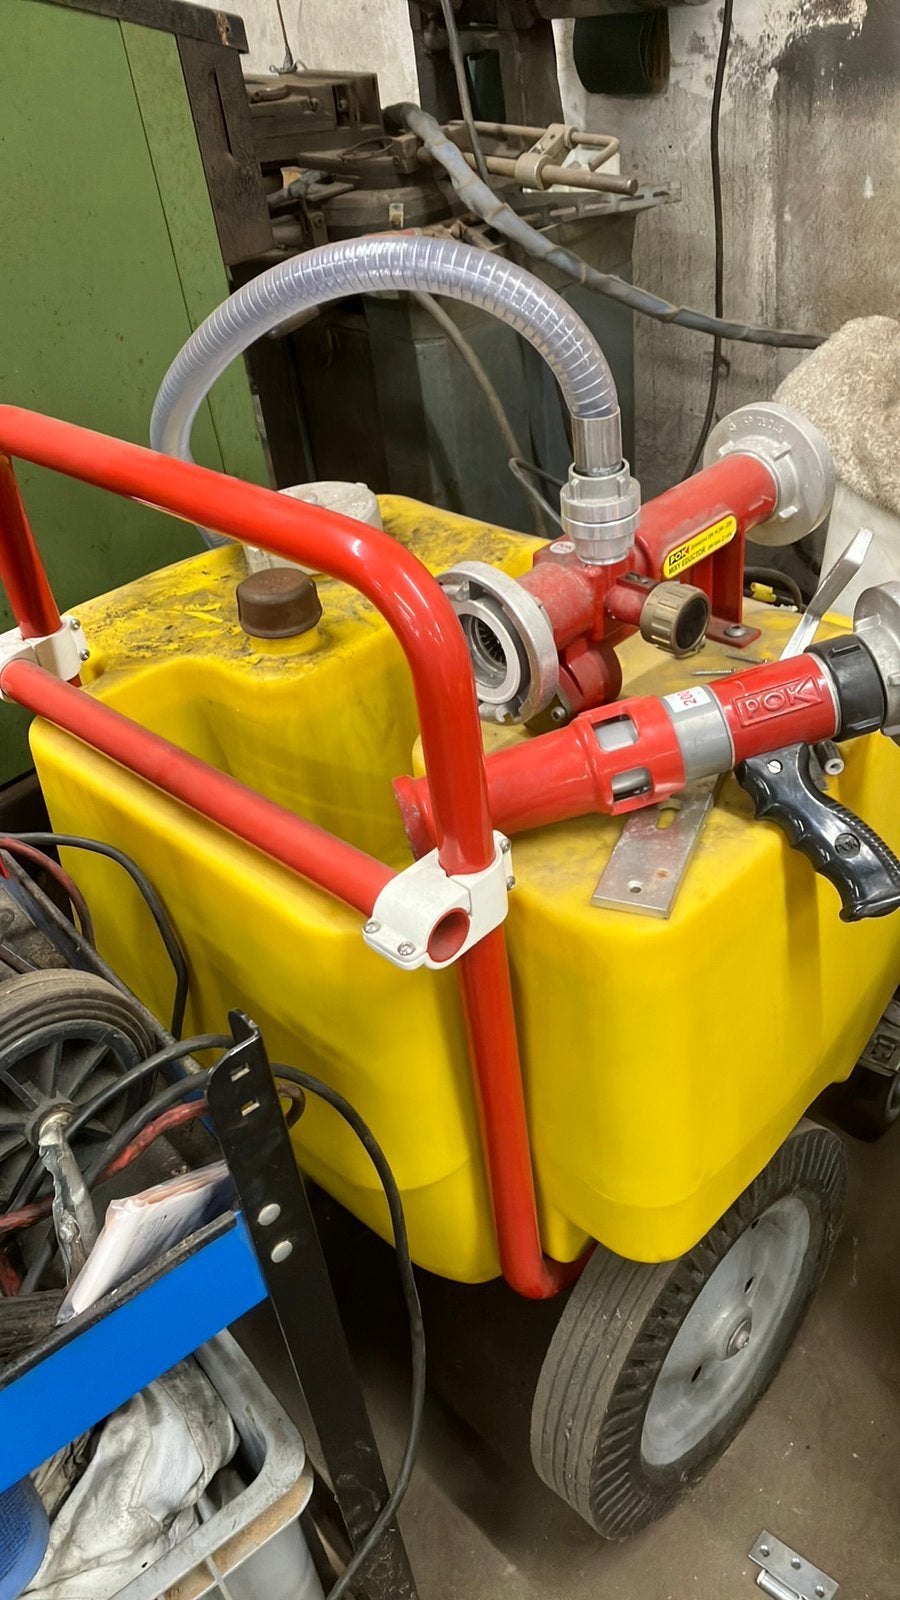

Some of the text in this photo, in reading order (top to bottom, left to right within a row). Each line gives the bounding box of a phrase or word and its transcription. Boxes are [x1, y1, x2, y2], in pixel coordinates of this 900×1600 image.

[669, 545, 690, 566] POK
[682, 546, 706, 567] EDUCTOR
[744, 675, 821, 720] POK
